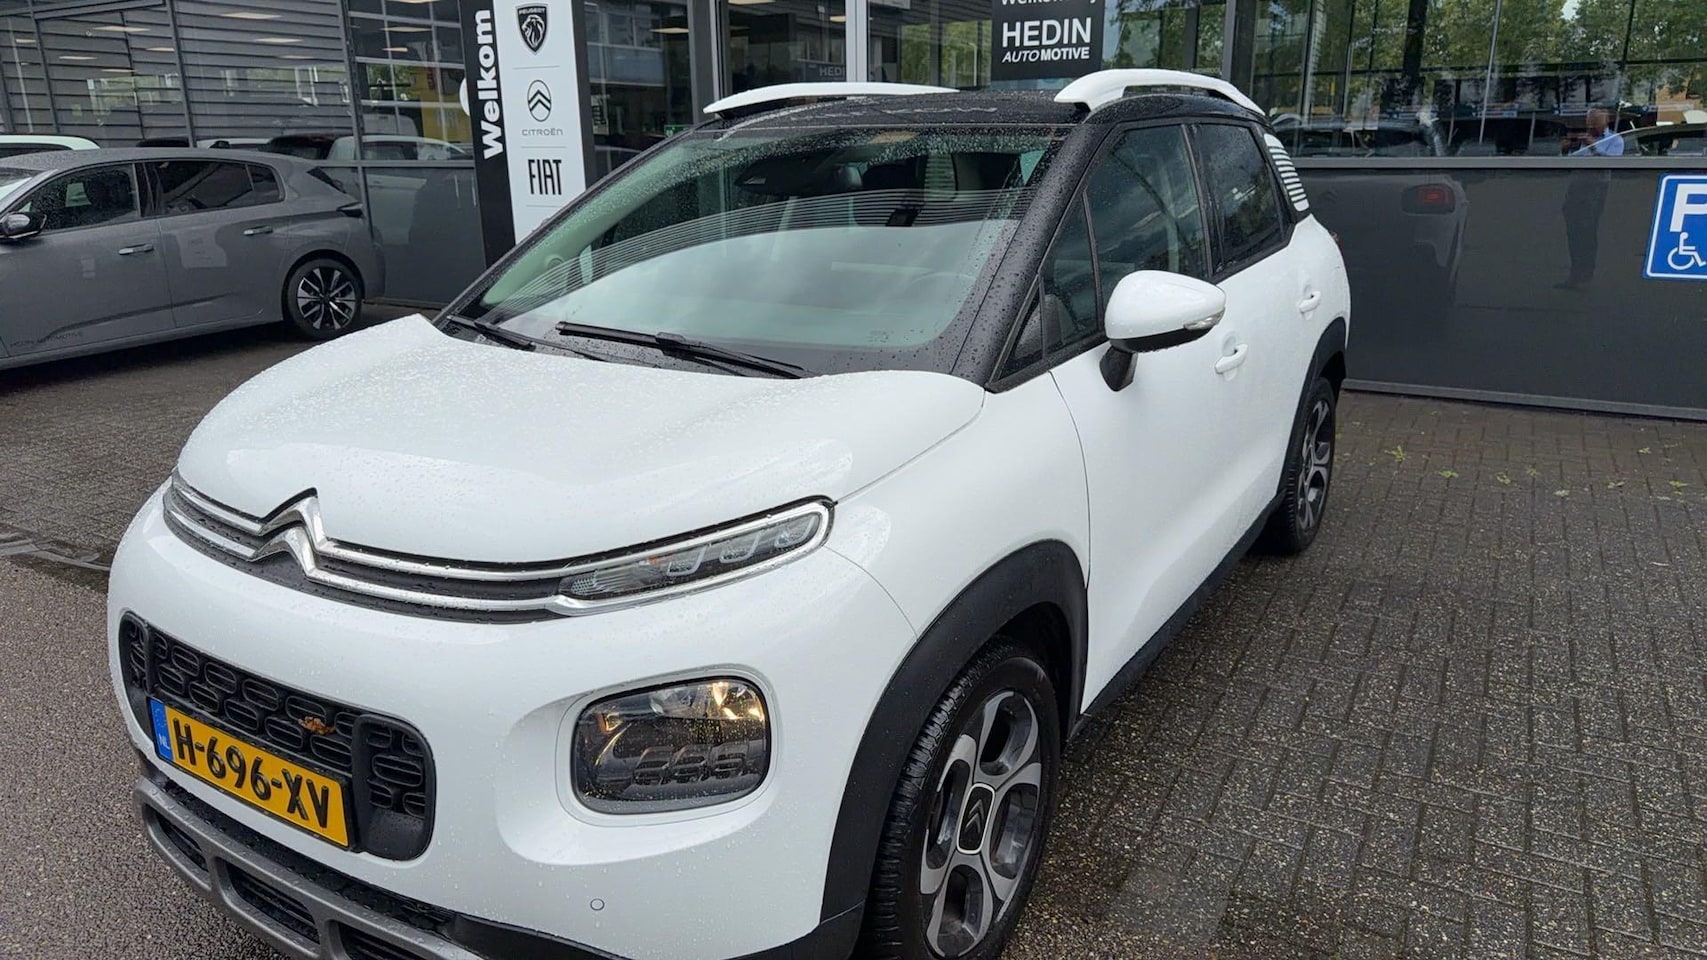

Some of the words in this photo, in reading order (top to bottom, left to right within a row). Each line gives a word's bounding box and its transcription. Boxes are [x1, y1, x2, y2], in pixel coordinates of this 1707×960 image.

[1002, 17, 1092, 48] HEDIN
[819, 66, 845, 77] HEDI
[1002, 47, 1090, 63] AUTOMOTIVE
[475, 9, 503, 160] Welkom
[528, 159, 562, 195] FIAT
[1669, 183, 1707, 232] P
[173, 718, 329, 829] H-696-XV
